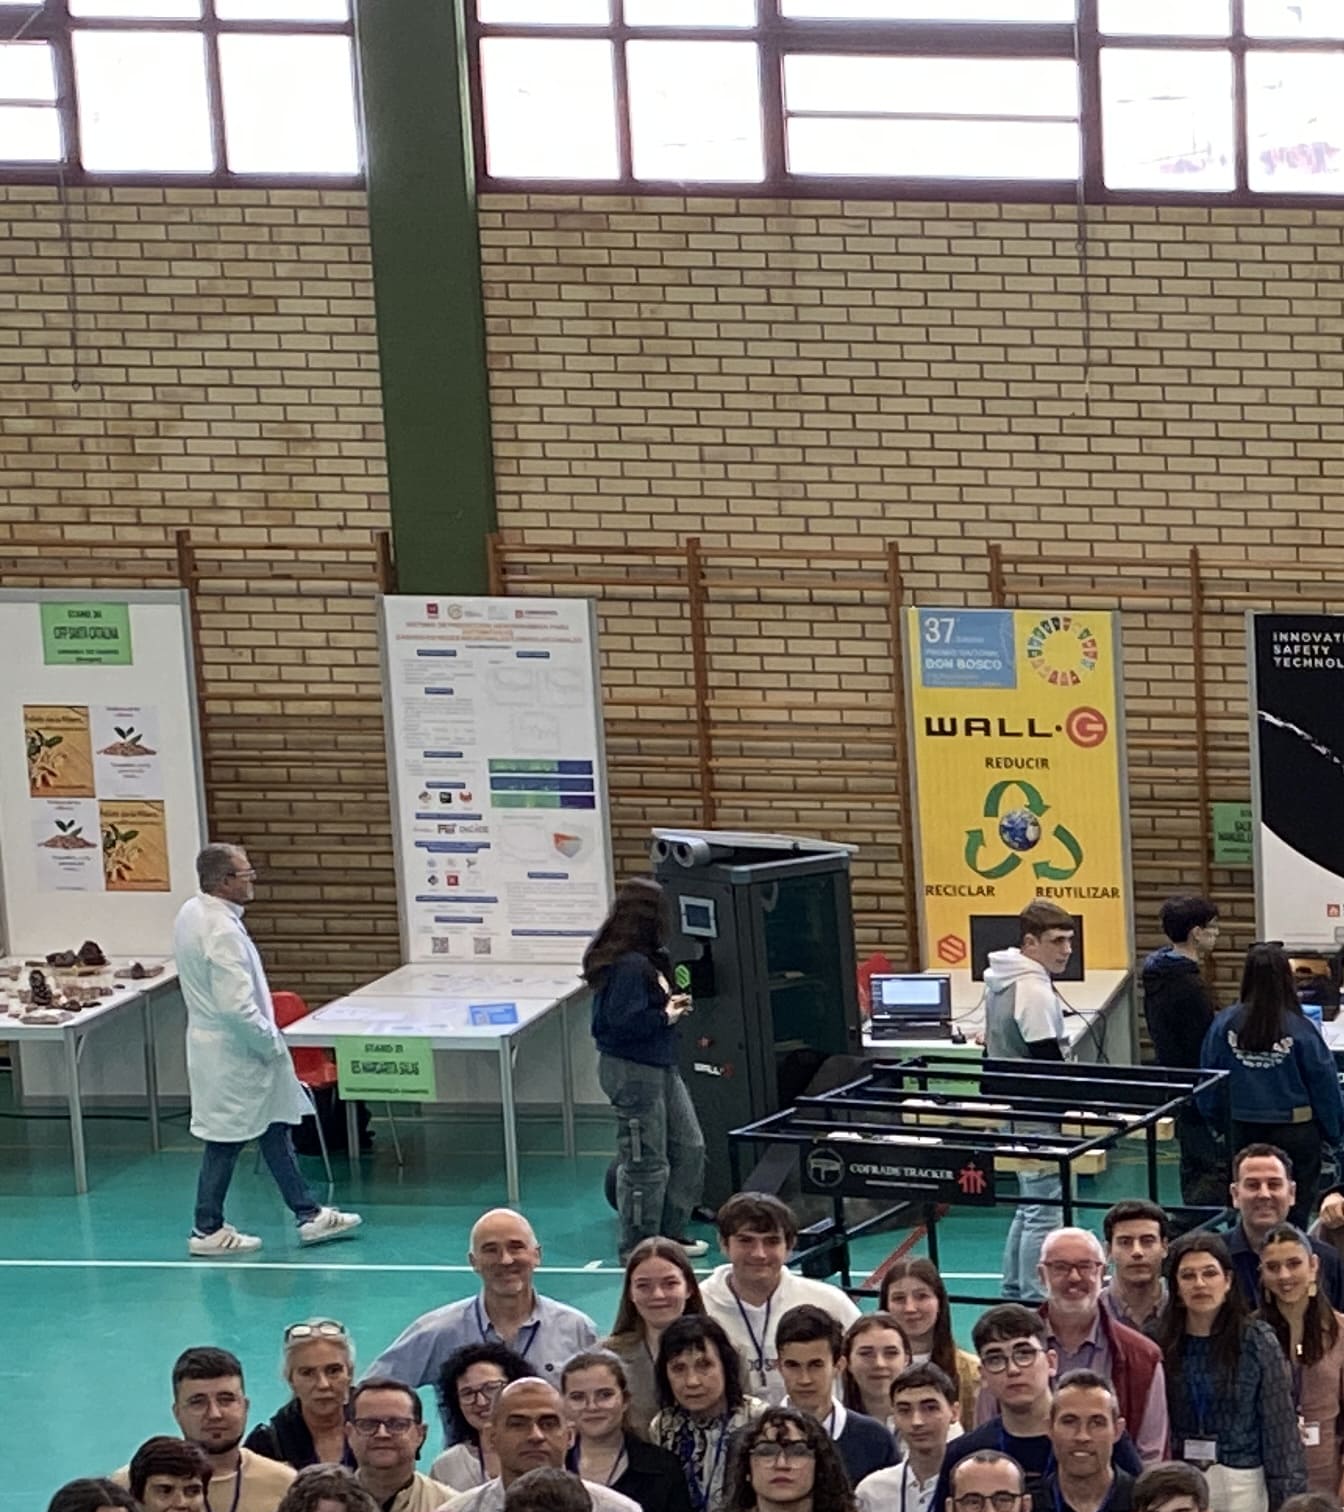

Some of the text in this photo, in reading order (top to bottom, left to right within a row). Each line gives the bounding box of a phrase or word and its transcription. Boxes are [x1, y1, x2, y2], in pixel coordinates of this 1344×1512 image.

[924, 617, 955, 643] 37
[1273, 644, 1330, 656] SAFETY
[925, 658, 1002, 670] DON BOSCO
[985, 757, 1050, 770] REDUCIR
[925, 884, 995, 897] RECICLAR
[1036, 886, 1121, 899] REUTILIZAR
[849, 1163, 954, 1180] COFRADE TRACKER
